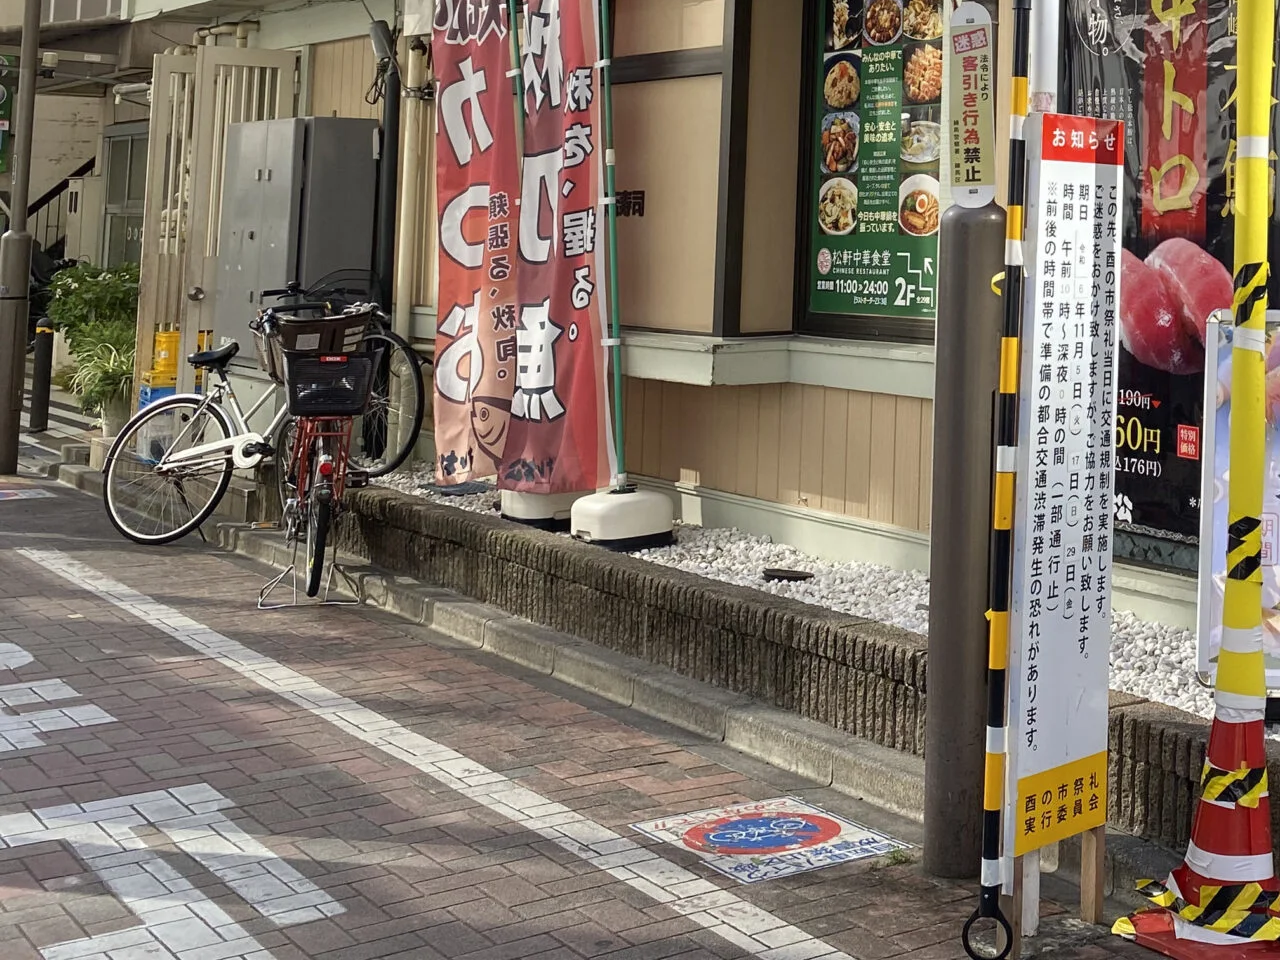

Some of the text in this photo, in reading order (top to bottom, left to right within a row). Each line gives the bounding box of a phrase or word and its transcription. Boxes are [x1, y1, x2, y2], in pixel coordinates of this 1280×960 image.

[954, 29, 987, 53] 迷惑
[862, 50, 902, 64] みんなの中華で
[868, 62, 895, 73] ありたい。
[980, 54, 989, 101] 法令により
[962, 56, 982, 182] 客引き行為禁止
[1052, 128, 1116, 151] お知らせ
[1062, 183, 1074, 221] 時間
[1078, 184, 1090, 221] 期日
[832, 249, 891, 266] 松軒中華食堂
[894, 277, 916, 306] 2F
[1096, 185, 1118, 619] この先、酉の市祭礼当日に交通規制を実施します。
[1118, 389, 1151, 410] 190円
[1078, 185, 1104, 658] ご迷惑をおかけ致しますが、ご協力をお願い致します。
[1180, 427, 1196, 442] 特別
[1180, 442, 1197, 456] 価格
[1025, 772, 1099, 813] 酉の市祭礼
[1024, 793, 1099, 835] 実行委員会
